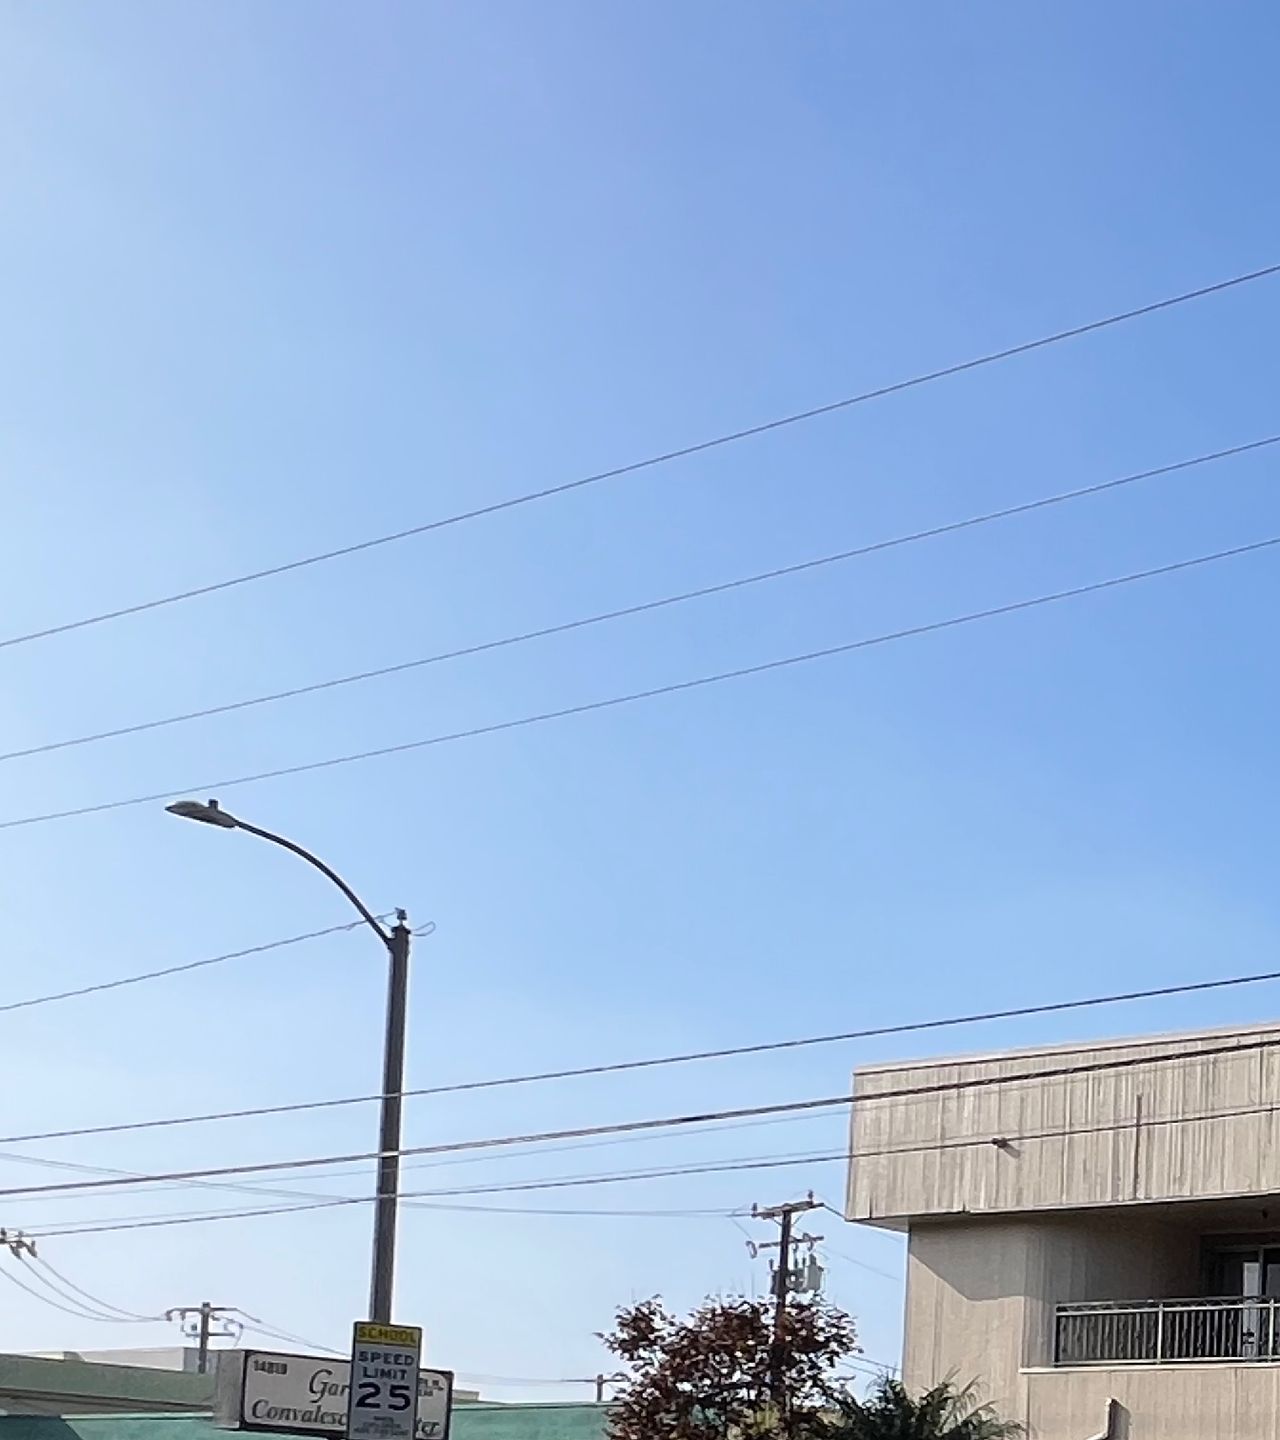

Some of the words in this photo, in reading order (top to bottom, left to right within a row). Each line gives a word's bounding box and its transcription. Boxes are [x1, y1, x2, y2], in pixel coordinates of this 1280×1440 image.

[358, 1326, 417, 1344] SCHOOL
[358, 1351, 414, 1366] SPEED
[362, 1367, 407, 1380] LIMIT
[355, 1382, 411, 1411] 25
